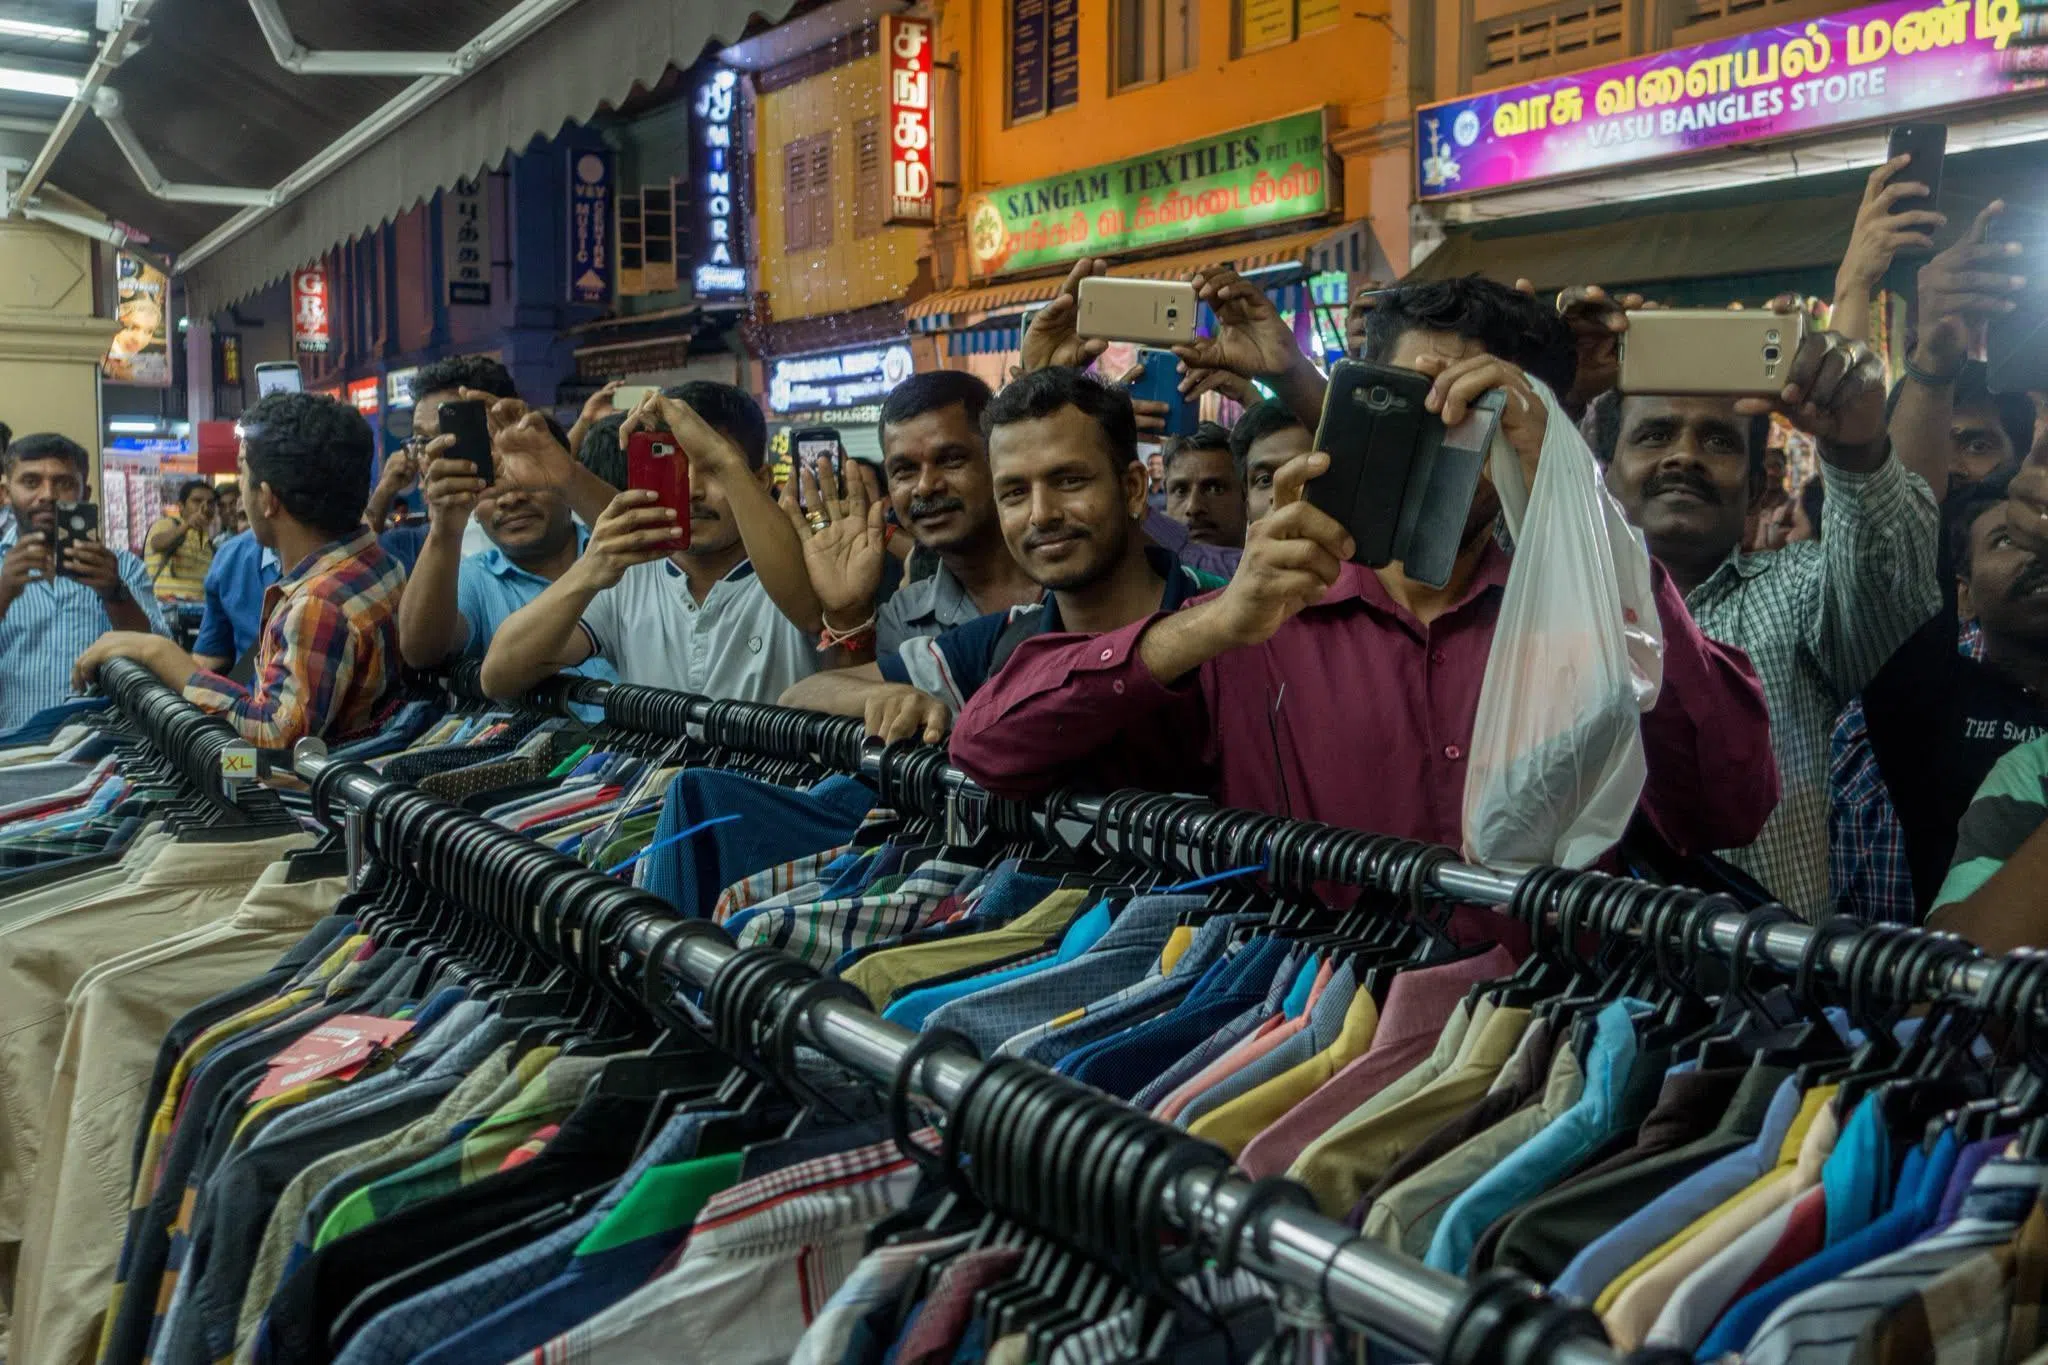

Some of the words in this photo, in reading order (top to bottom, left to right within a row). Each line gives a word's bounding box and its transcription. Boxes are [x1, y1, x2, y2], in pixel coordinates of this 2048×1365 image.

[893, 23, 929, 198] சங்கம்
[1493, 86, 1584, 138] வாசு
[1595, 23, 1831, 116] வளையல்
[1587, 112, 1655, 148] VASU
[1659, 85, 1784, 136] BANGLES
[1790, 67, 1887, 111] STORE
[706, 125, 732, 265] MINORA
[1007, 172, 1110, 220] SANGAM
[1119, 135, 1262, 195] TEXTILES
[225, 756, 253, 772] XL
[1965, 717, 1998, 739] THE
